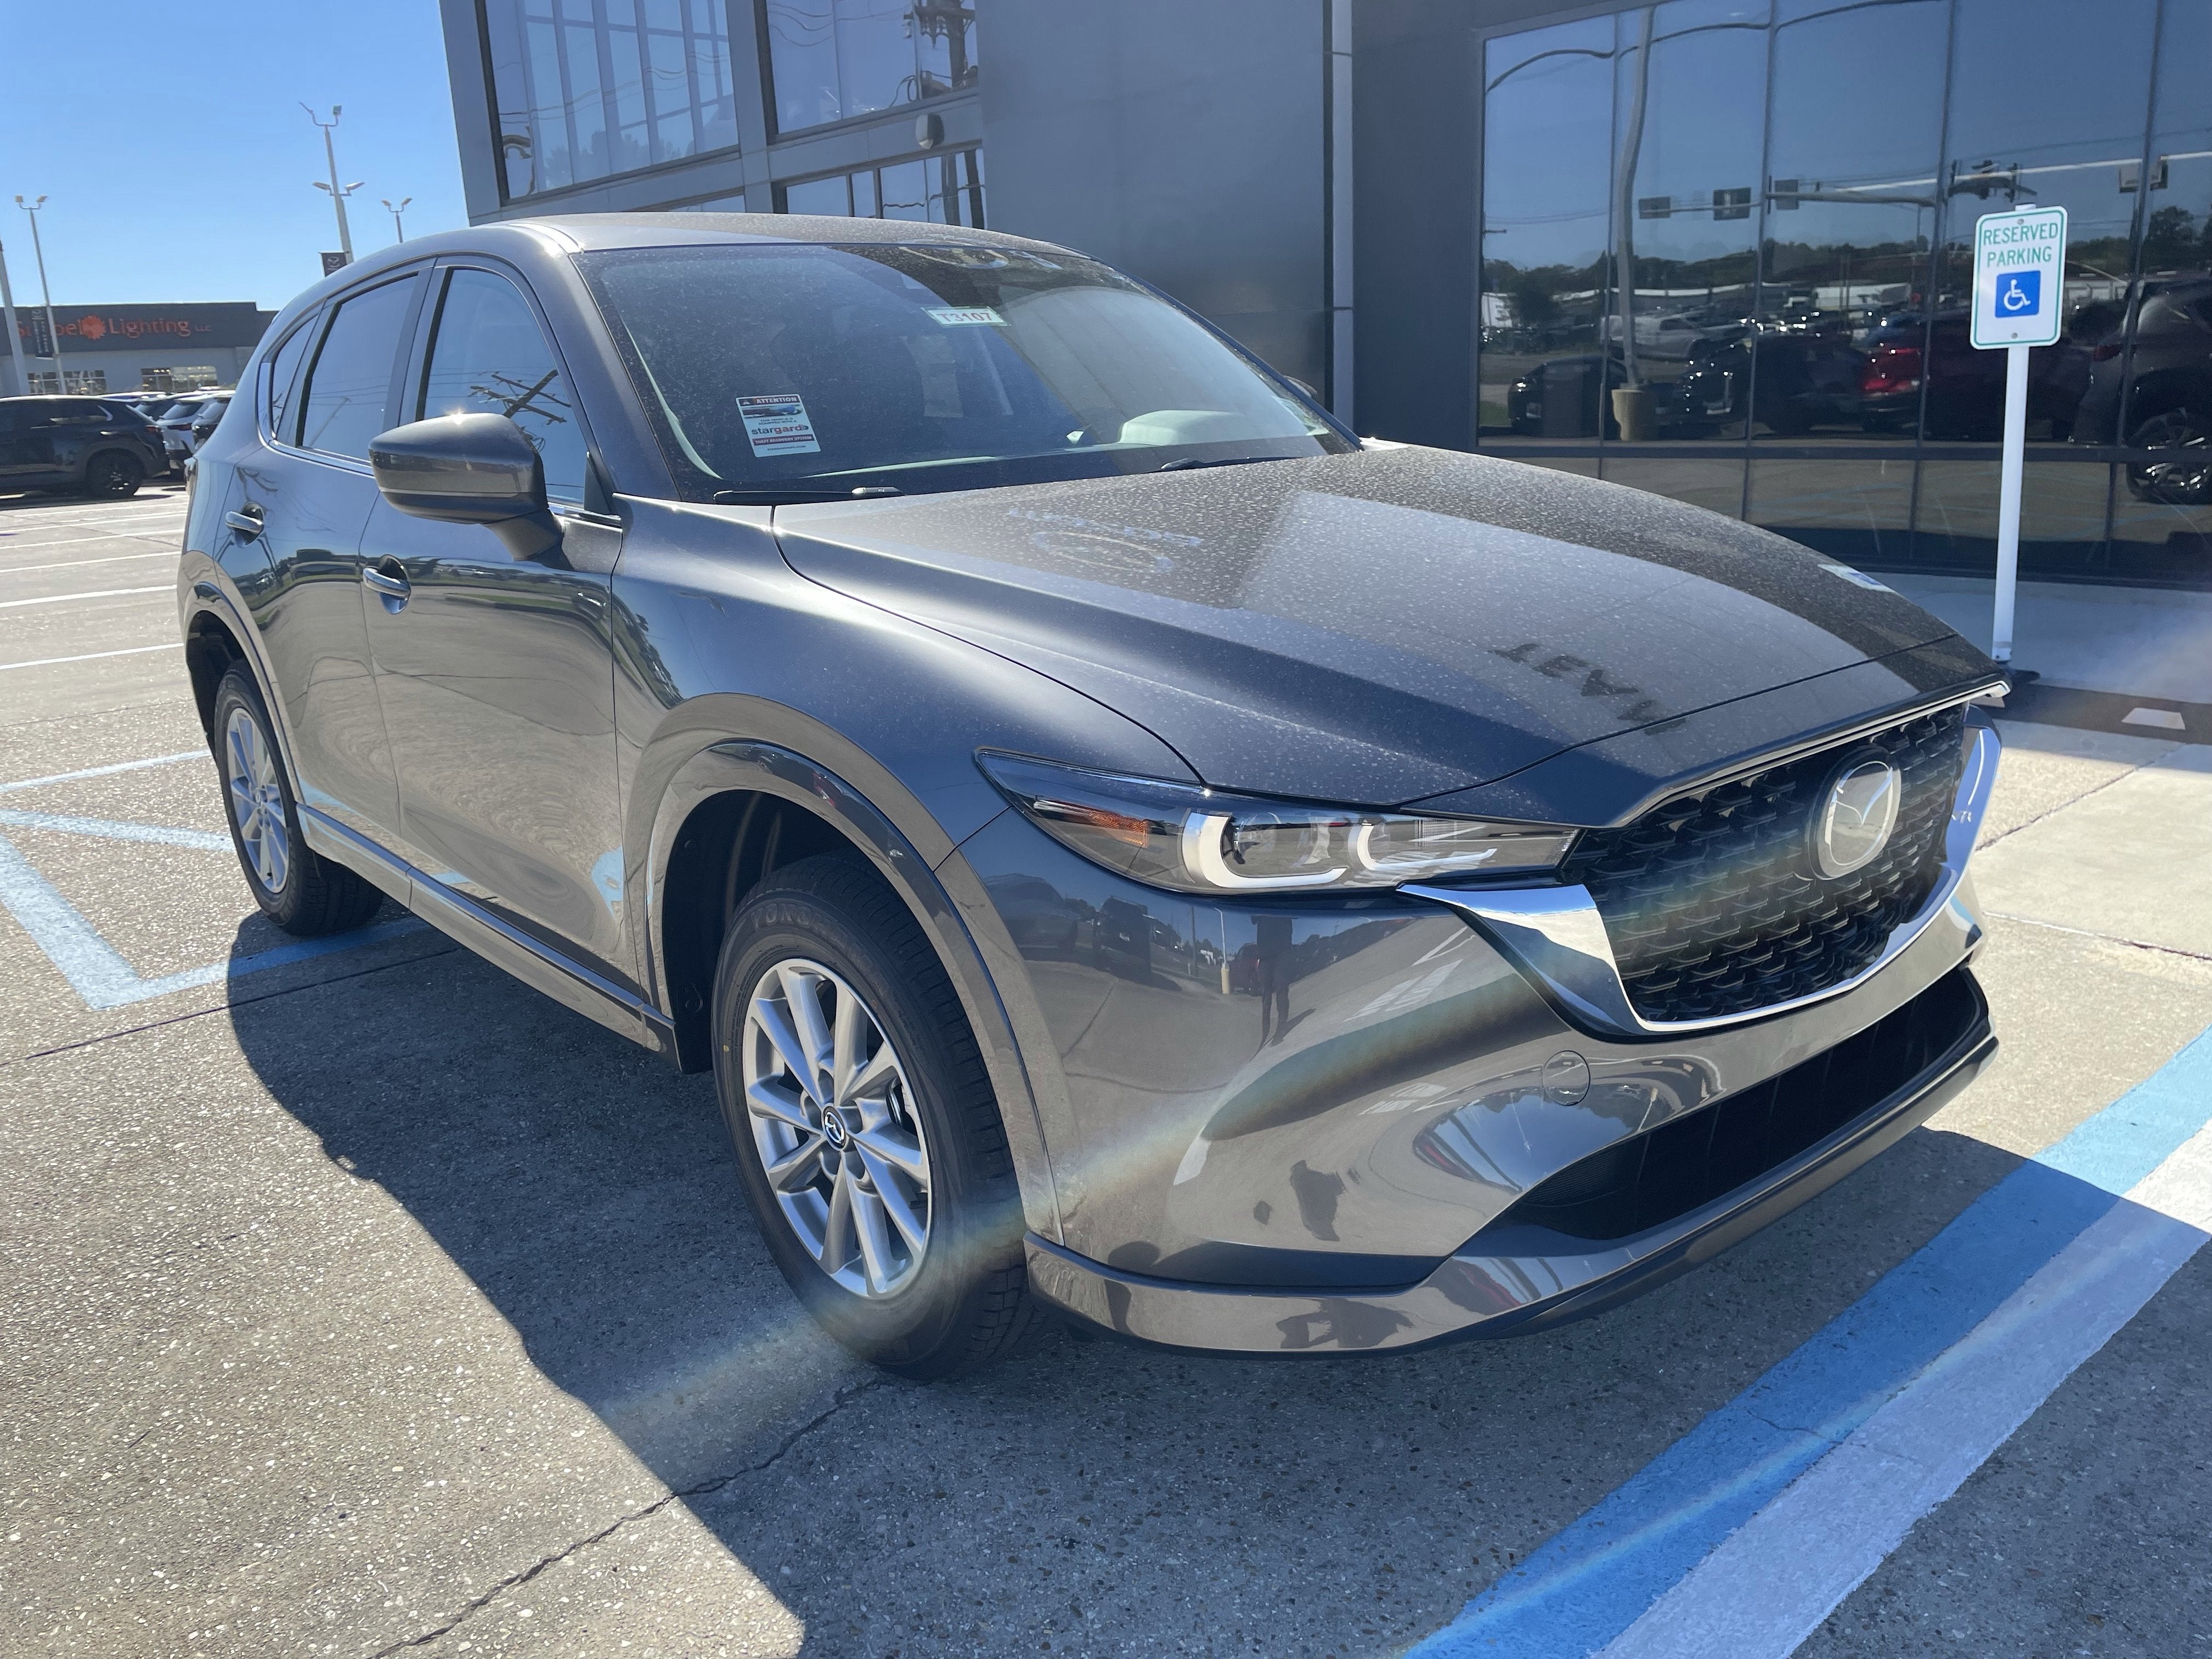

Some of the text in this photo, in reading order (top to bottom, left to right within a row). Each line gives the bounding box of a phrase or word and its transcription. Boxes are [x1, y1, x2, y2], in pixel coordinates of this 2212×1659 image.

[1983, 222, 2058, 245] RESERVED
[1987, 246, 2052, 267] PARKING
[936, 312, 992, 322] T3107
[109, 318, 191, 338] Lighting
[751, 424, 803, 435] stargard
[749, 902, 888, 997] YOKOHAMA
